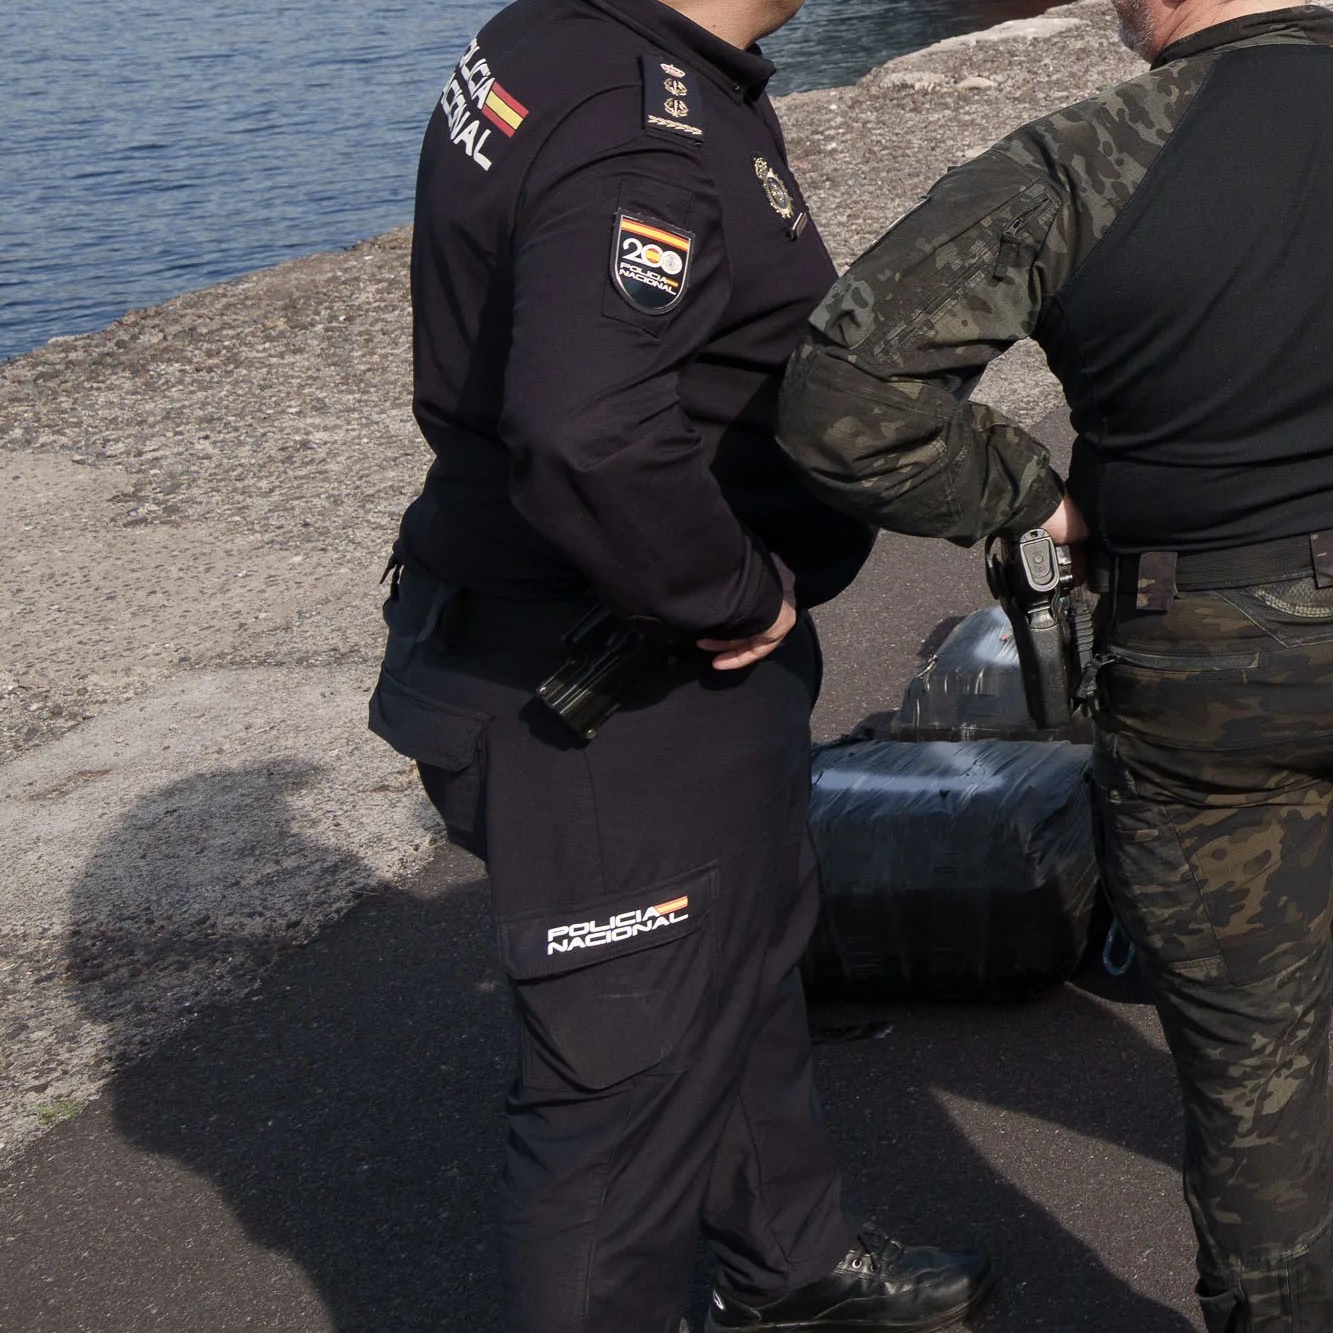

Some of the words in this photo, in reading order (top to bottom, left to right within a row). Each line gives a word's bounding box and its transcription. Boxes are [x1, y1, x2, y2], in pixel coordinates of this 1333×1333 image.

[622, 237, 683, 275] 200
[619, 268, 677, 296] NACIONAL
[547, 912, 689, 955] NACIONAL
